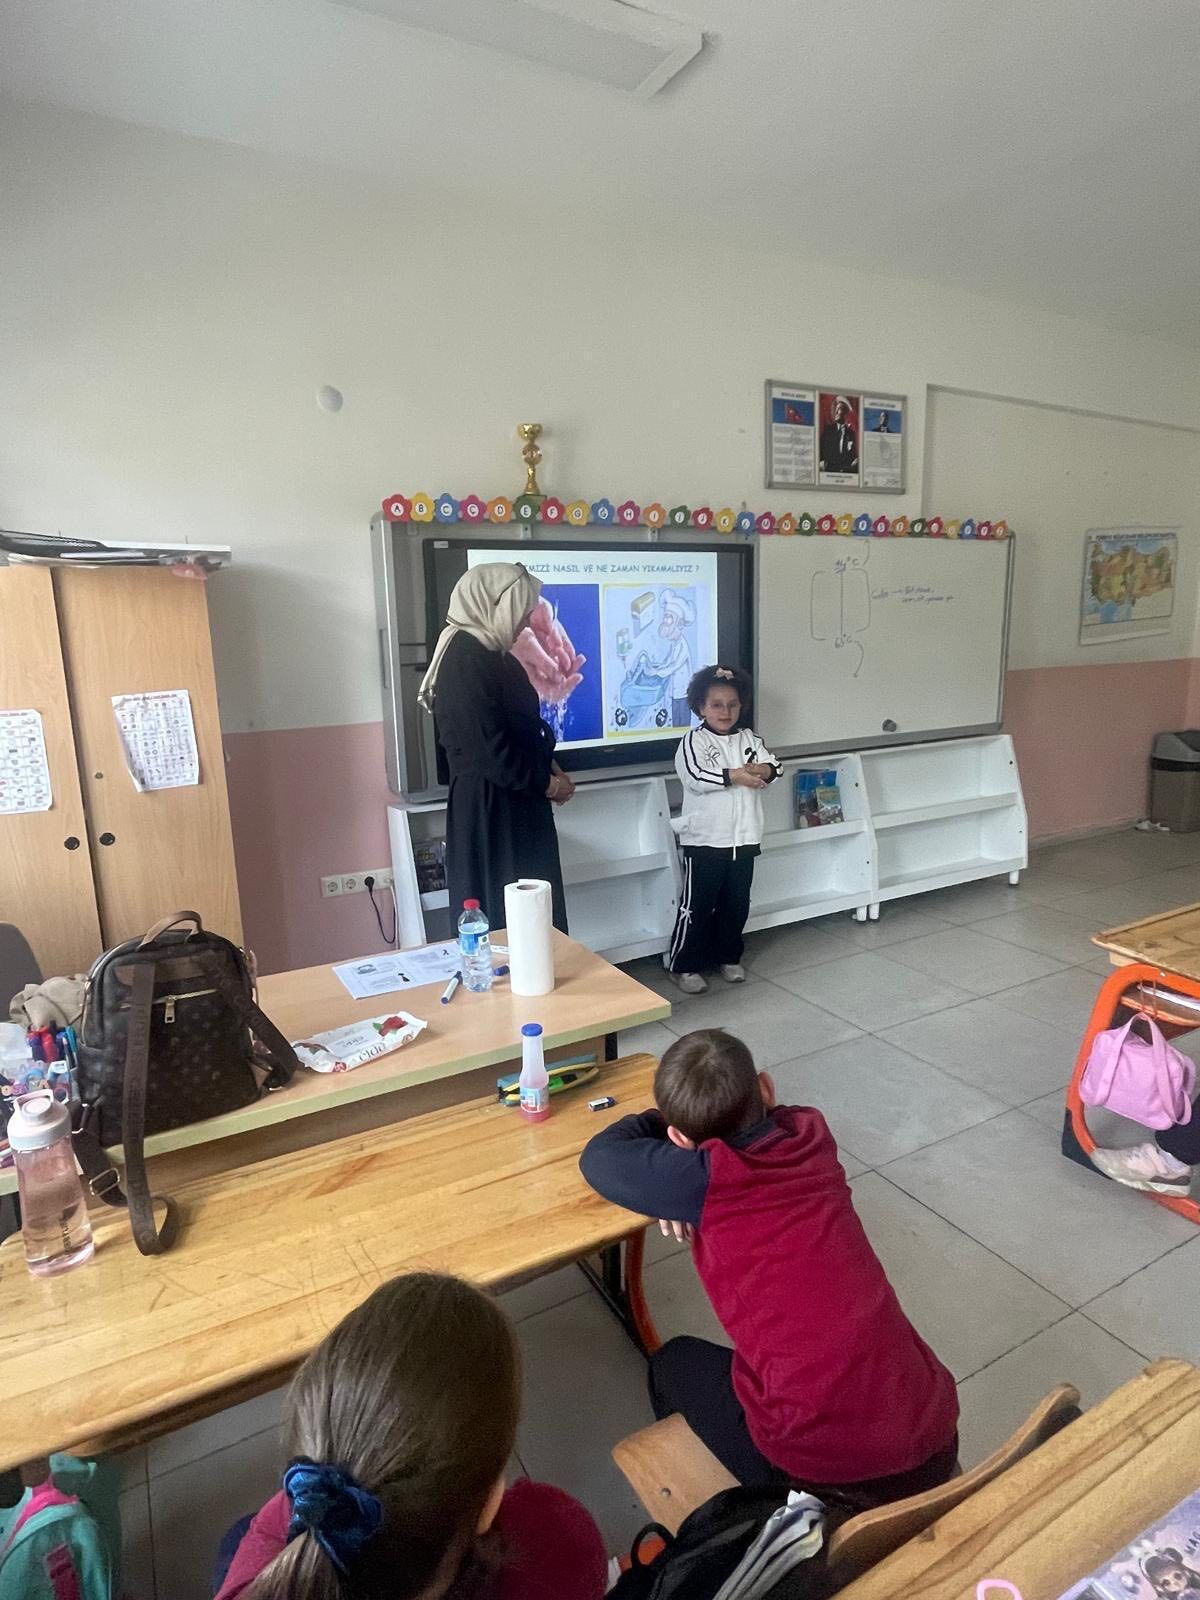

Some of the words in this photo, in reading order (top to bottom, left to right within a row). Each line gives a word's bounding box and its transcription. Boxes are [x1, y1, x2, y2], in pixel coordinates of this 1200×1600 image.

[554, 564, 580, 573] NASIL
[584, 564, 593, 573] VE
[597, 564, 608, 573] NE
[611, 564, 640, 573] ZAMAN
[642, 564, 693, 574] YIKAMALIYIZ
